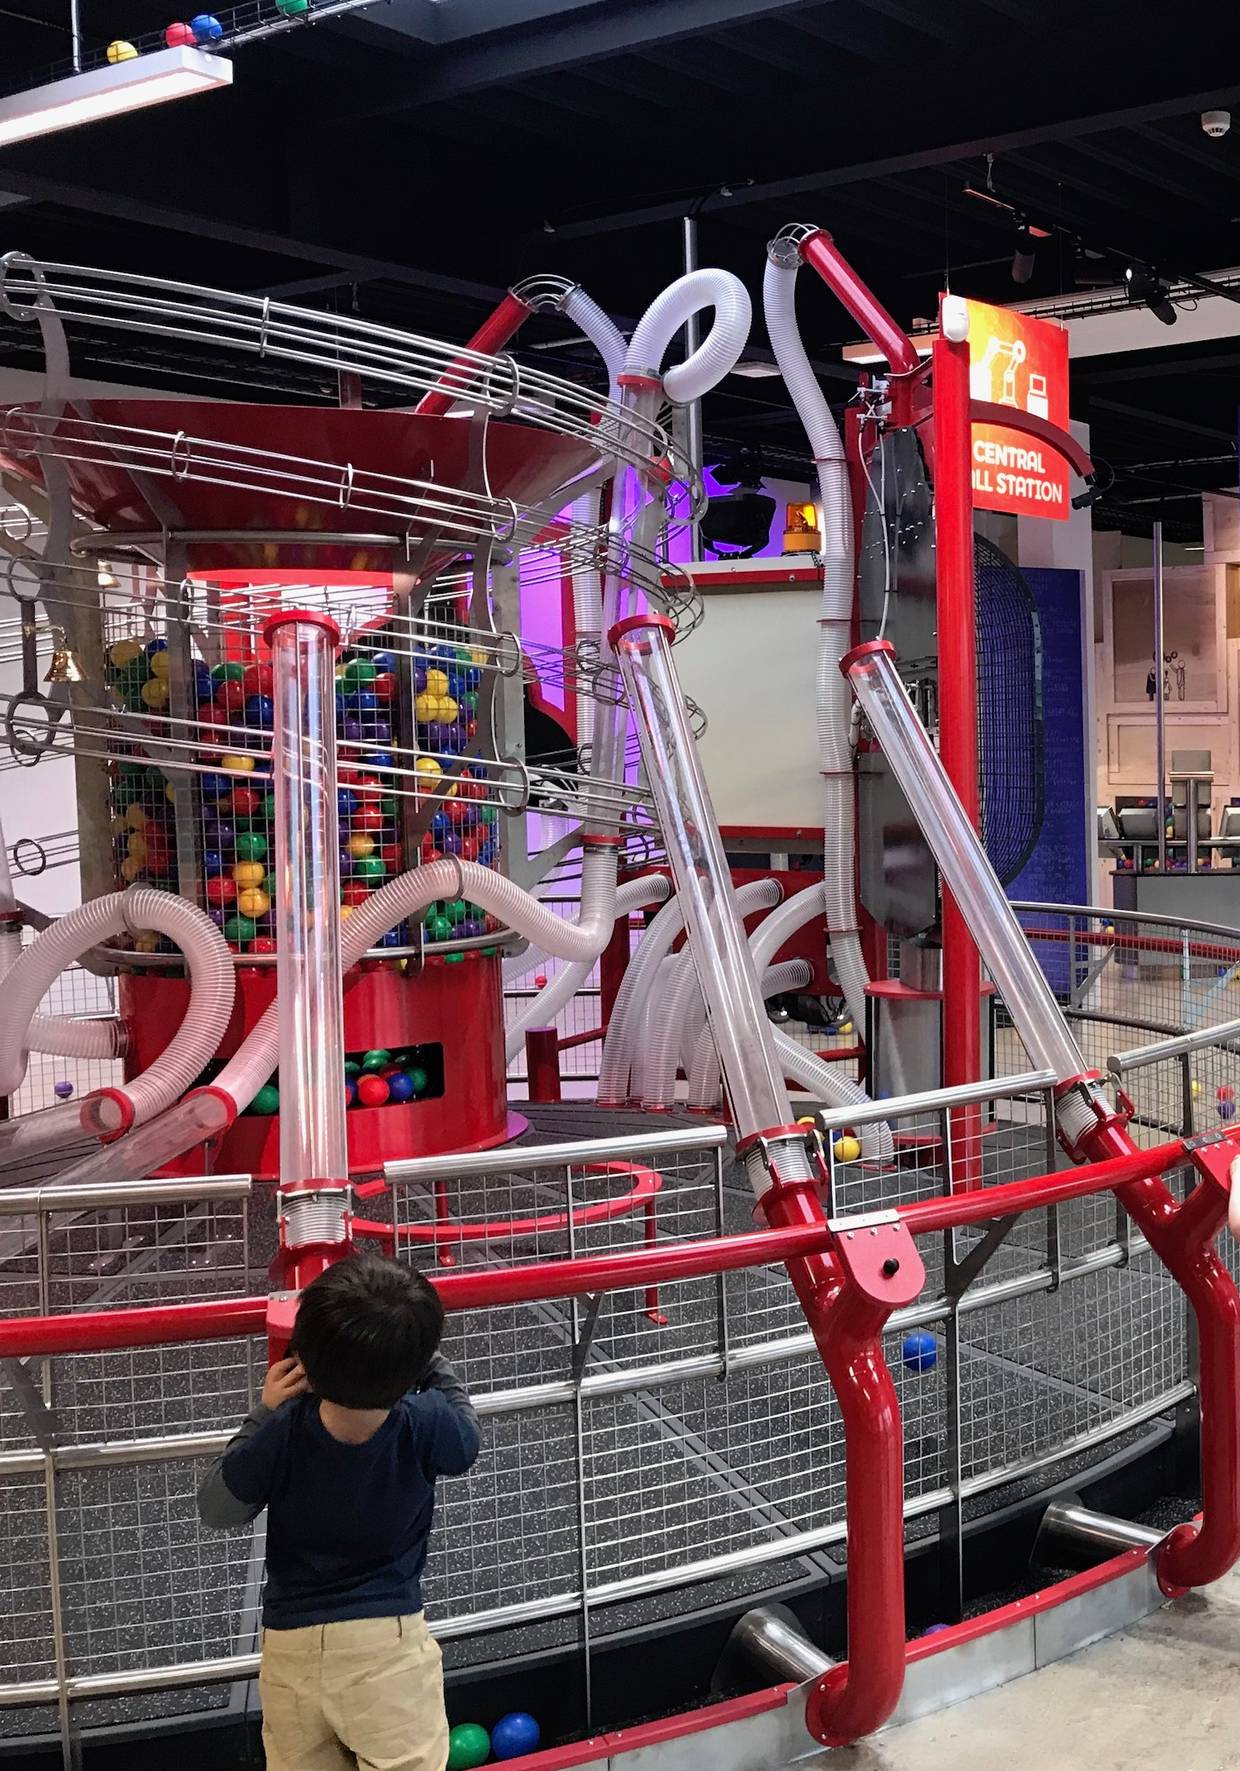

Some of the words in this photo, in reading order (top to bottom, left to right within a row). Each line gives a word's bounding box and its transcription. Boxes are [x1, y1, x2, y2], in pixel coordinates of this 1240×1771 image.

[973, 439, 1046, 474] CENTRAL
[971, 468, 994, 493] LL
[996, 472, 1063, 504] STATION
